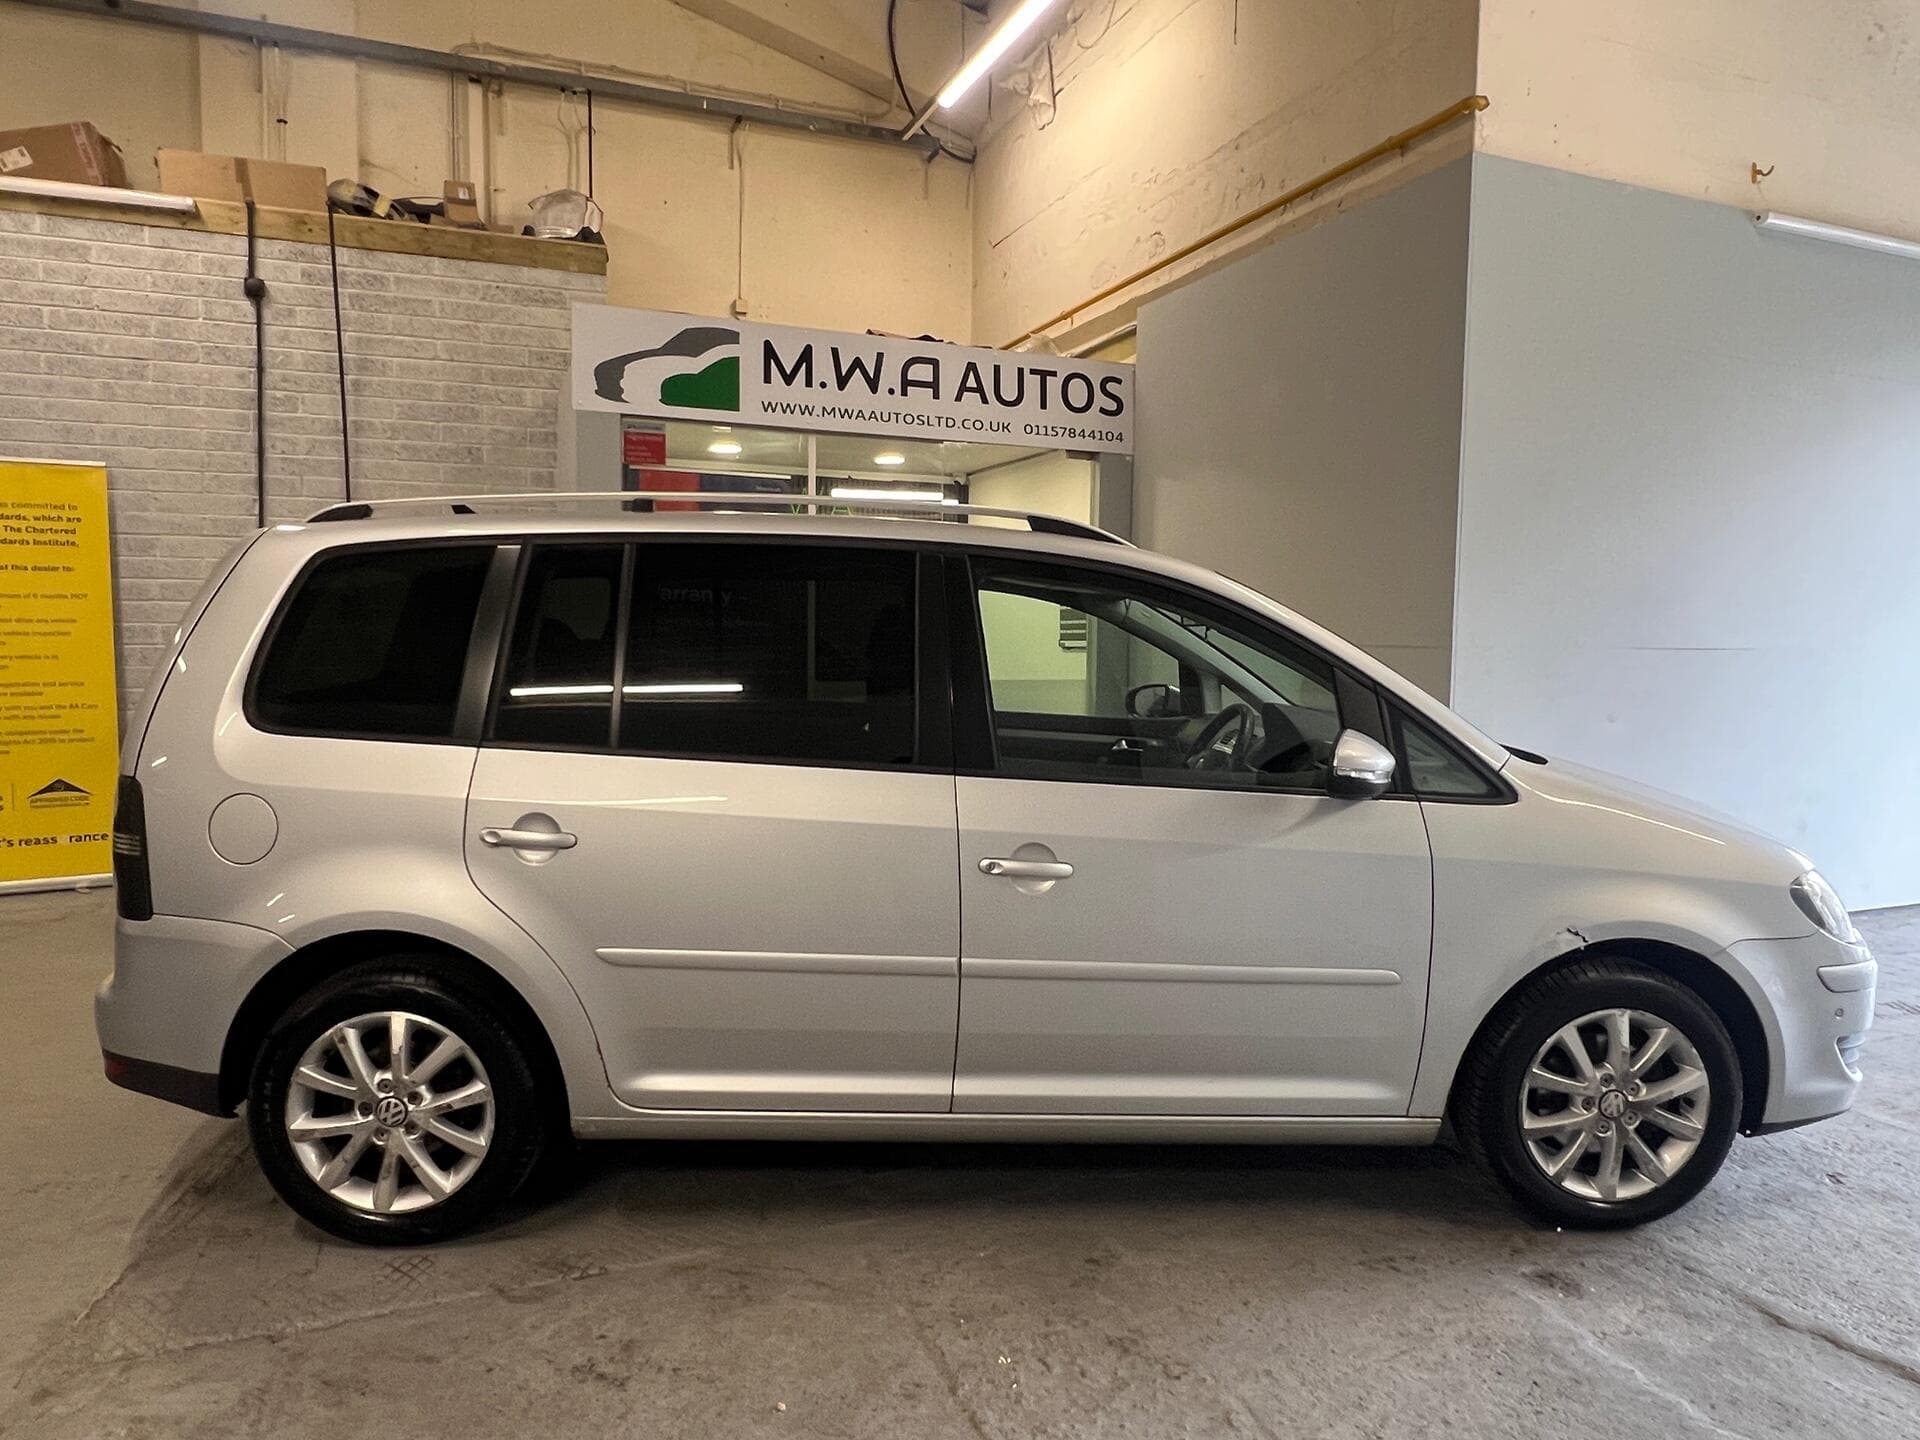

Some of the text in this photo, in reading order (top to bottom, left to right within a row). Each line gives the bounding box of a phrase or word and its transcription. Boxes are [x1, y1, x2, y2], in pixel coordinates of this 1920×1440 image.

[954, 361, 1124, 417] AUTOS
[761, 400, 1124, 443] WWW.MWAAUTOSLTD.CO.UK 01157844104
[11, 501, 65, 511] committed
[68, 503, 78, 511] to
[33, 514, 63, 523] which
[3, 525, 77, 535] The Chartered
[11, 563, 28, 571] this
